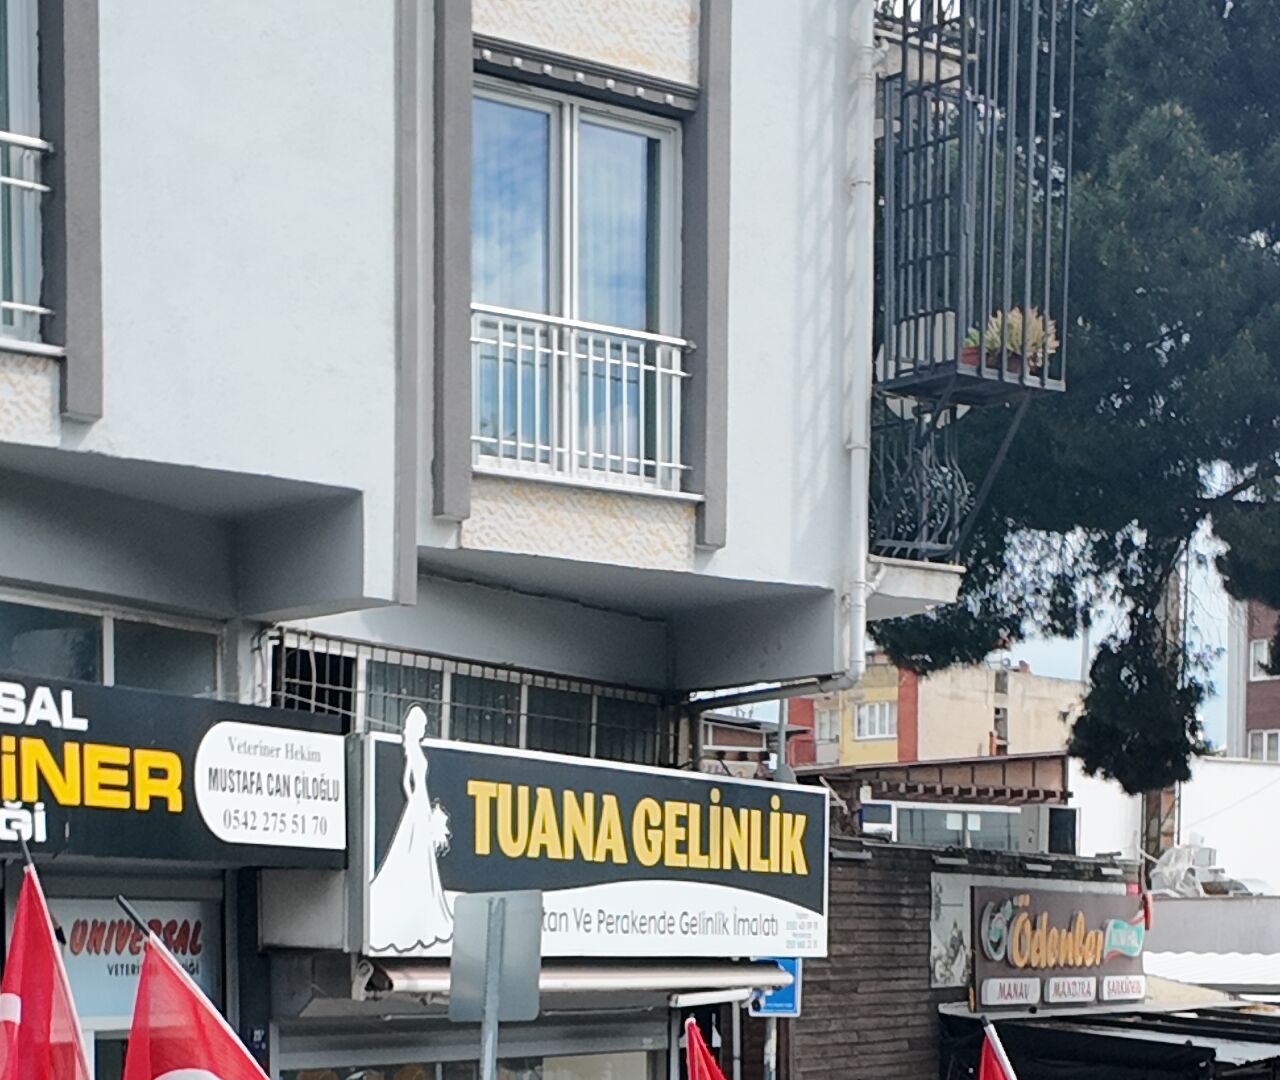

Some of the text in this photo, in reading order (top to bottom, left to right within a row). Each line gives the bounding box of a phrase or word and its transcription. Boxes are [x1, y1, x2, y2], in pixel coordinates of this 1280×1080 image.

[228, 736, 321, 762] Veteriner Hekim
[208, 766, 340, 804] MUSTAFA CAN ÇİLOĞLU
[223, 809, 327, 836] 0542 275 51 70
[467, 780, 808, 875] TUANA GELİNLİK
[573, 907, 593, 933] Ve
[596, 909, 675, 936] Perakende
[679, 909, 731, 936] Gelinlik
[733, 905, 778, 937] İmalatı
[998, 982, 1030, 1000] MANAV
